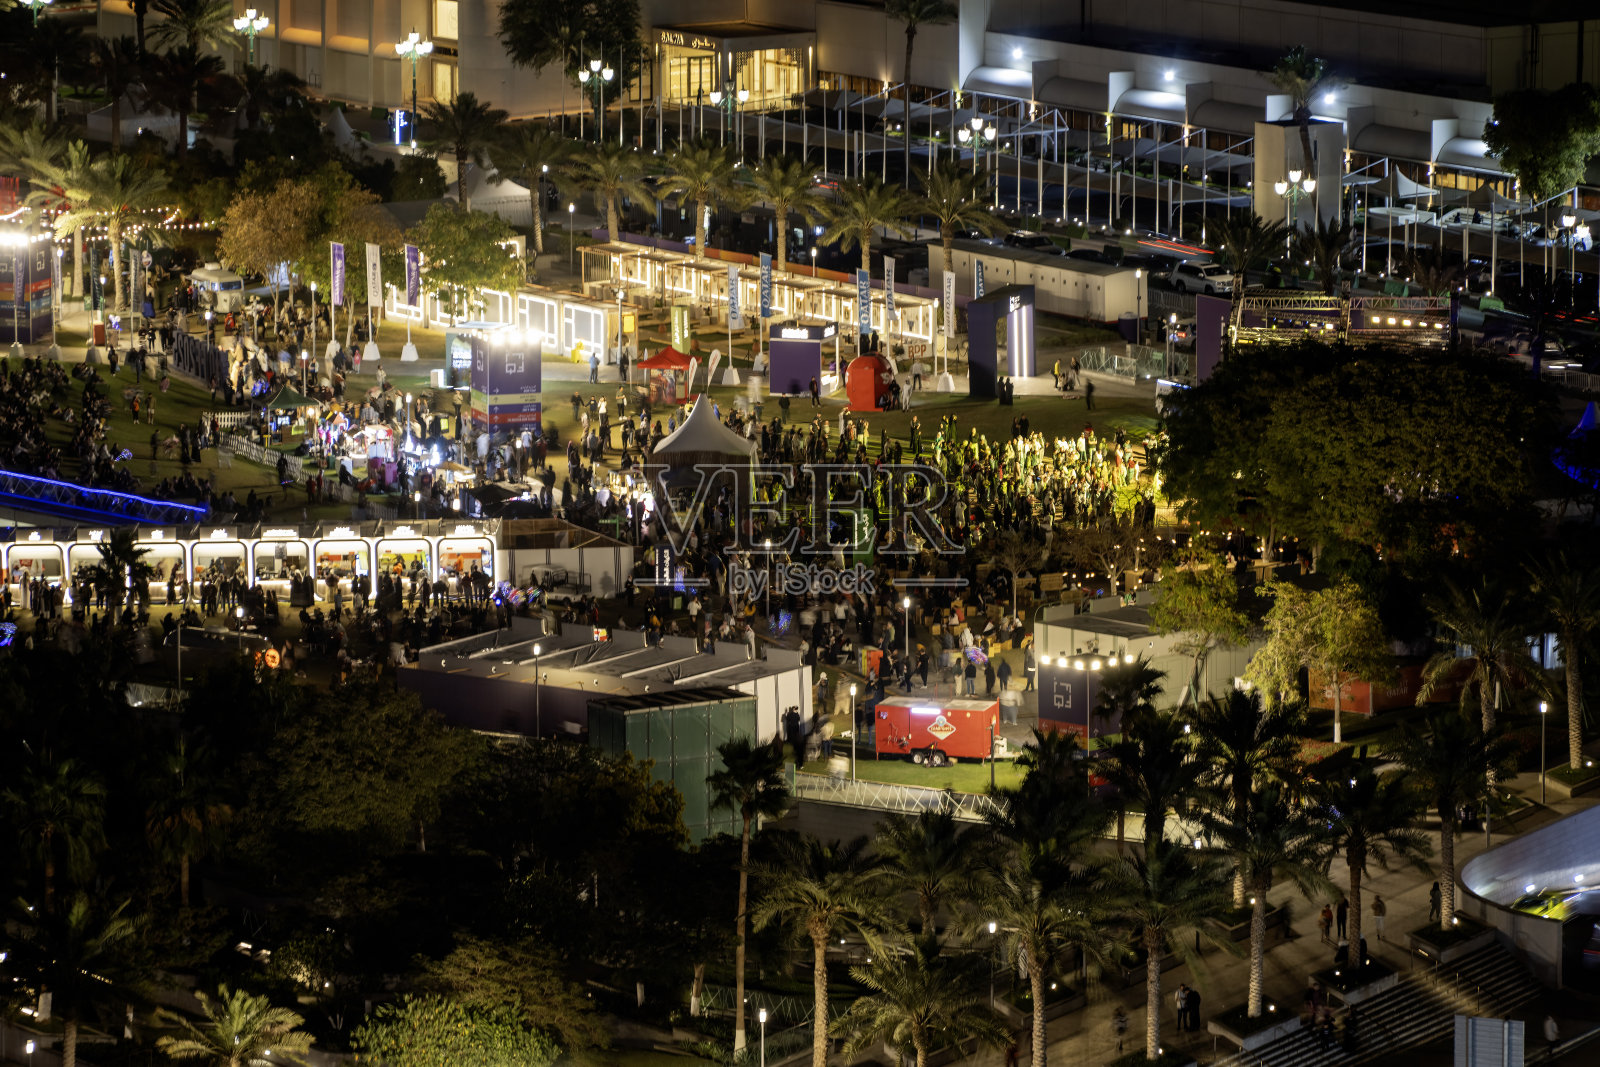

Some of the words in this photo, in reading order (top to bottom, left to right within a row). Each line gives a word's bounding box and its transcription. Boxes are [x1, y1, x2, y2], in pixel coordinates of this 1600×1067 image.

[729, 278, 738, 320] QATAR
[761, 264, 770, 309] QATAR
[860, 280, 869, 324] QATAR
[886, 268, 895, 311] QATAR
[945, 276, 953, 310] QATAR
